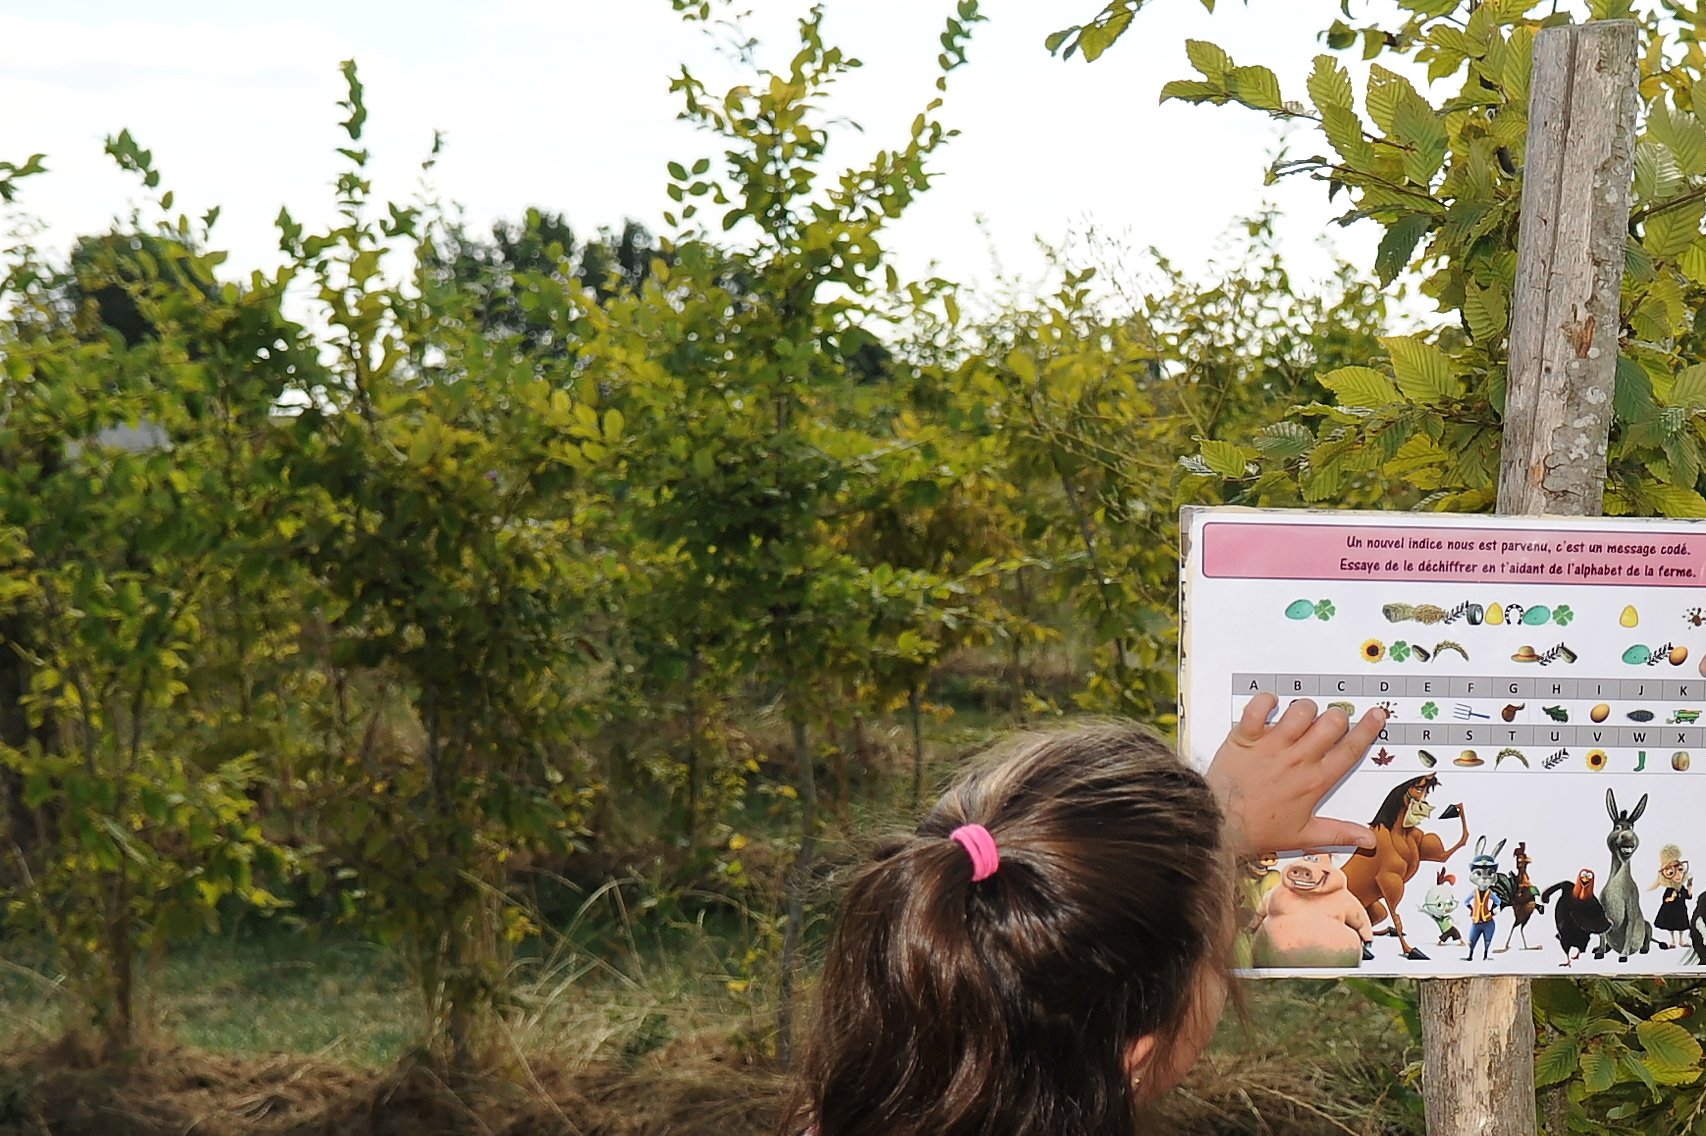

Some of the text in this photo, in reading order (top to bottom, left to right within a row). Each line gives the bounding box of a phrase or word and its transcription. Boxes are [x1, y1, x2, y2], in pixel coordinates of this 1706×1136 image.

[1346, 535, 1691, 558] Un nouvel indice nous est parvenu, c'est un message codé.
[1339, 557, 1697, 579] Essaye de le déchiffrer en t'aidant de l'alphabet de la ferme.
[1249, 679, 1259, 691] A
[1294, 680, 1302, 691] B
[1337, 680, 1346, 692] C
[1380, 681, 1389, 692] D
[1509, 683, 1518, 694] G
[1552, 683, 1561, 695] H
[1679, 685, 1688, 697] K
[1378, 729, 1389, 741] Q
[1422, 729, 1431, 741] R
[1465, 729, 1473, 741] S
[1508, 730, 1517, 741] T
[1550, 731, 1560, 742] U
[1593, 731, 1602, 743] V
[1633, 732, 1647, 743] W
[1677, 732, 1686, 744] X
